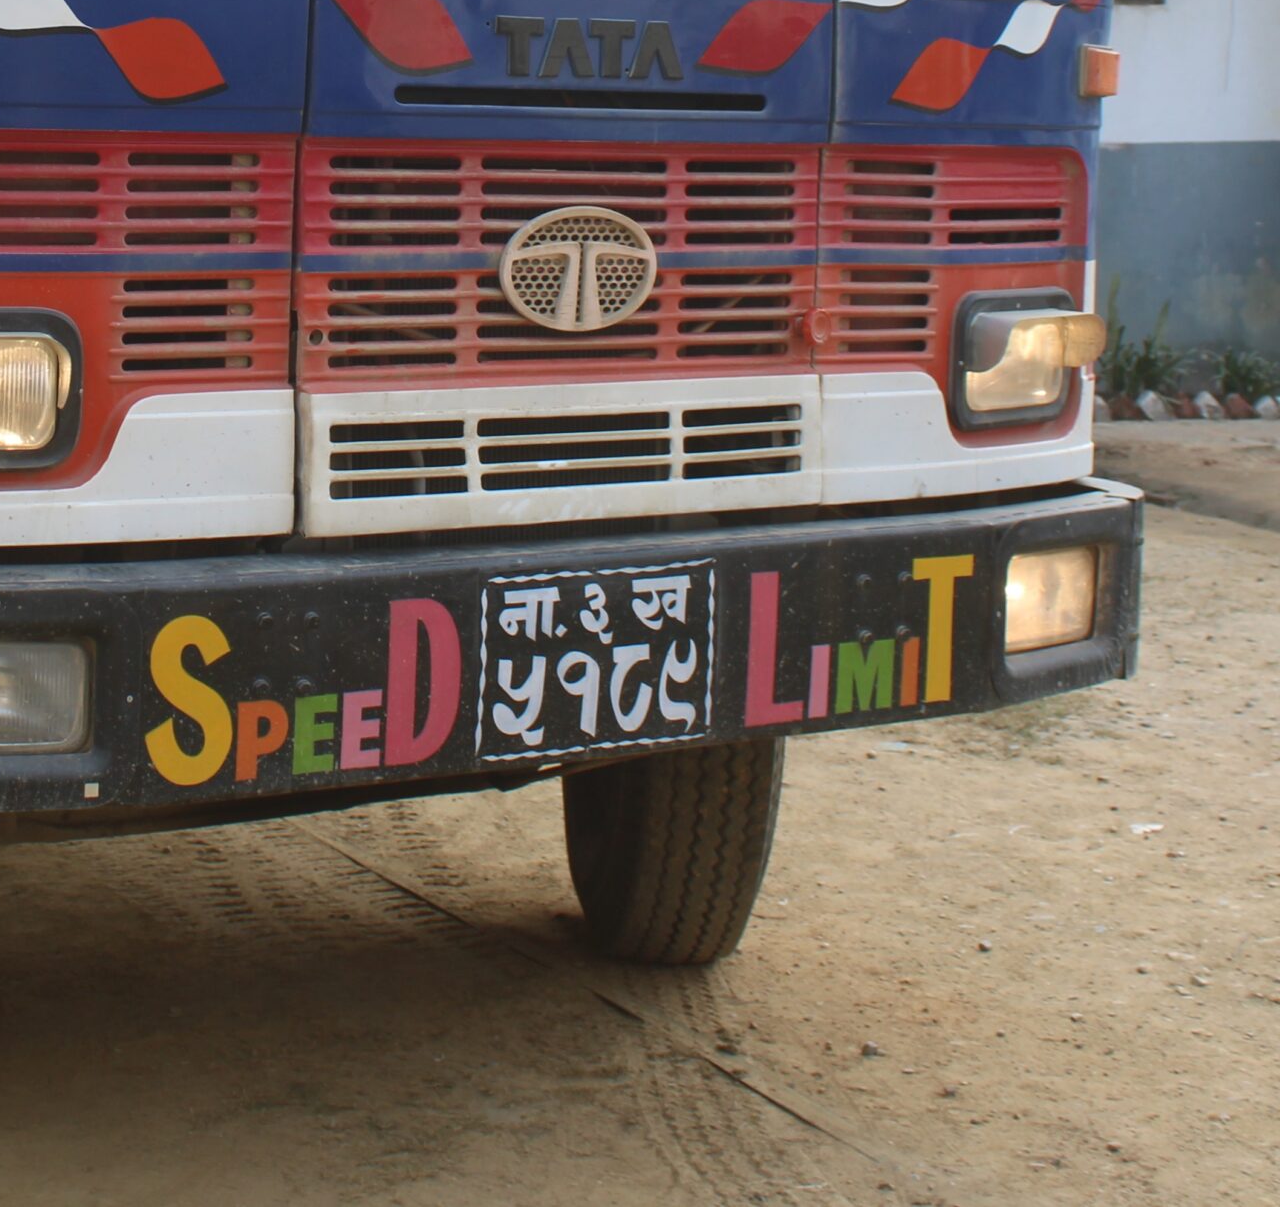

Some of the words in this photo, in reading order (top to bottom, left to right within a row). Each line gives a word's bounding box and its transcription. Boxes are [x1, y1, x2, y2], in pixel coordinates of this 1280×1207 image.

[496, 15, 684, 80] TATA
[145, 596, 462, 786] SPEED
[744, 554, 975, 729] LIMIT
